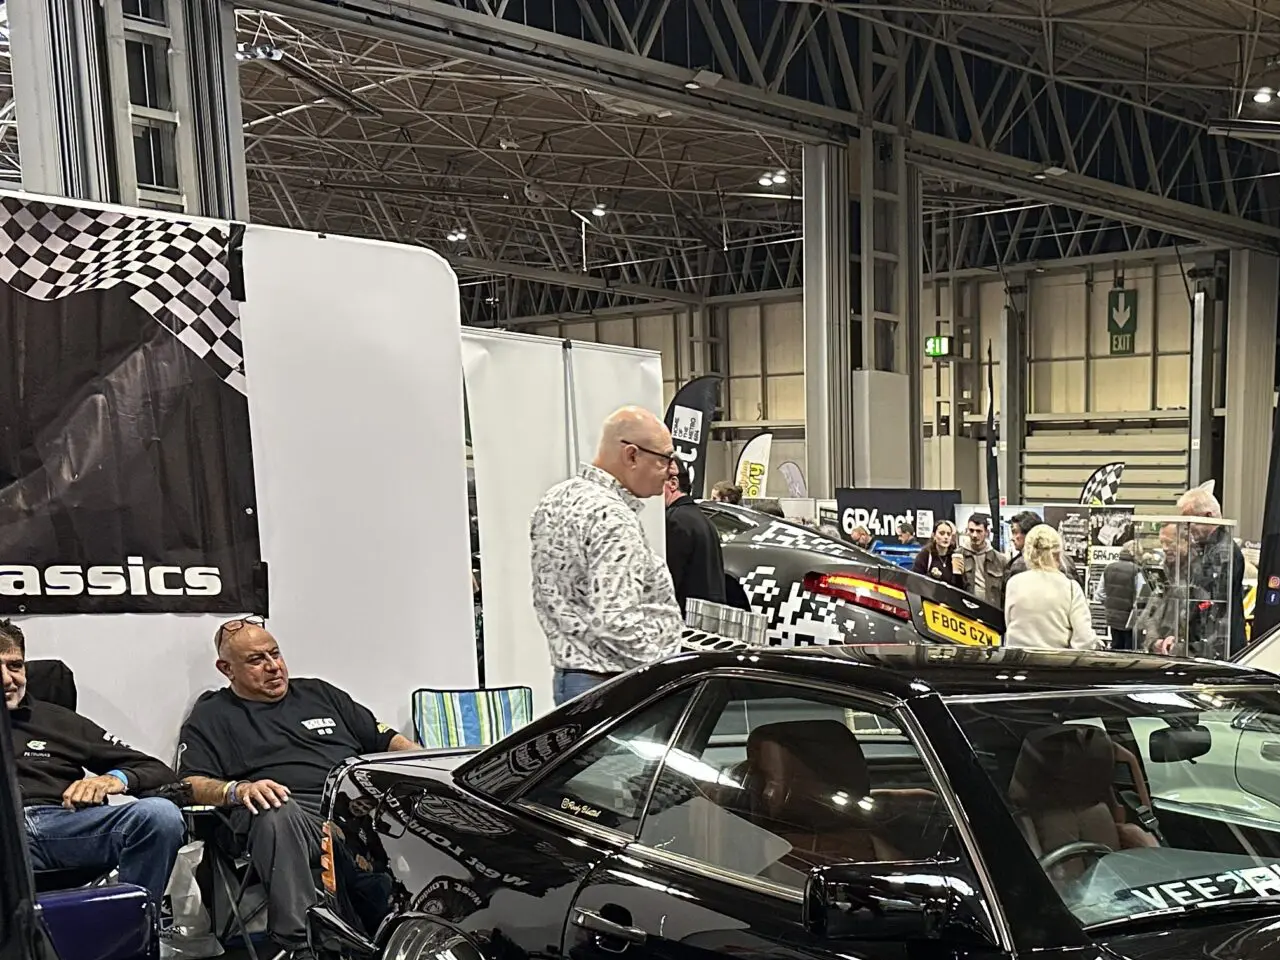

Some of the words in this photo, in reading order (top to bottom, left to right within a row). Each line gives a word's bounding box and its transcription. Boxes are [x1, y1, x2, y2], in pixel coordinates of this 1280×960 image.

[1113, 334, 1131, 351] EXIT
[842, 507, 914, 538] 6R4.net
[0, 556, 222, 596] assics
